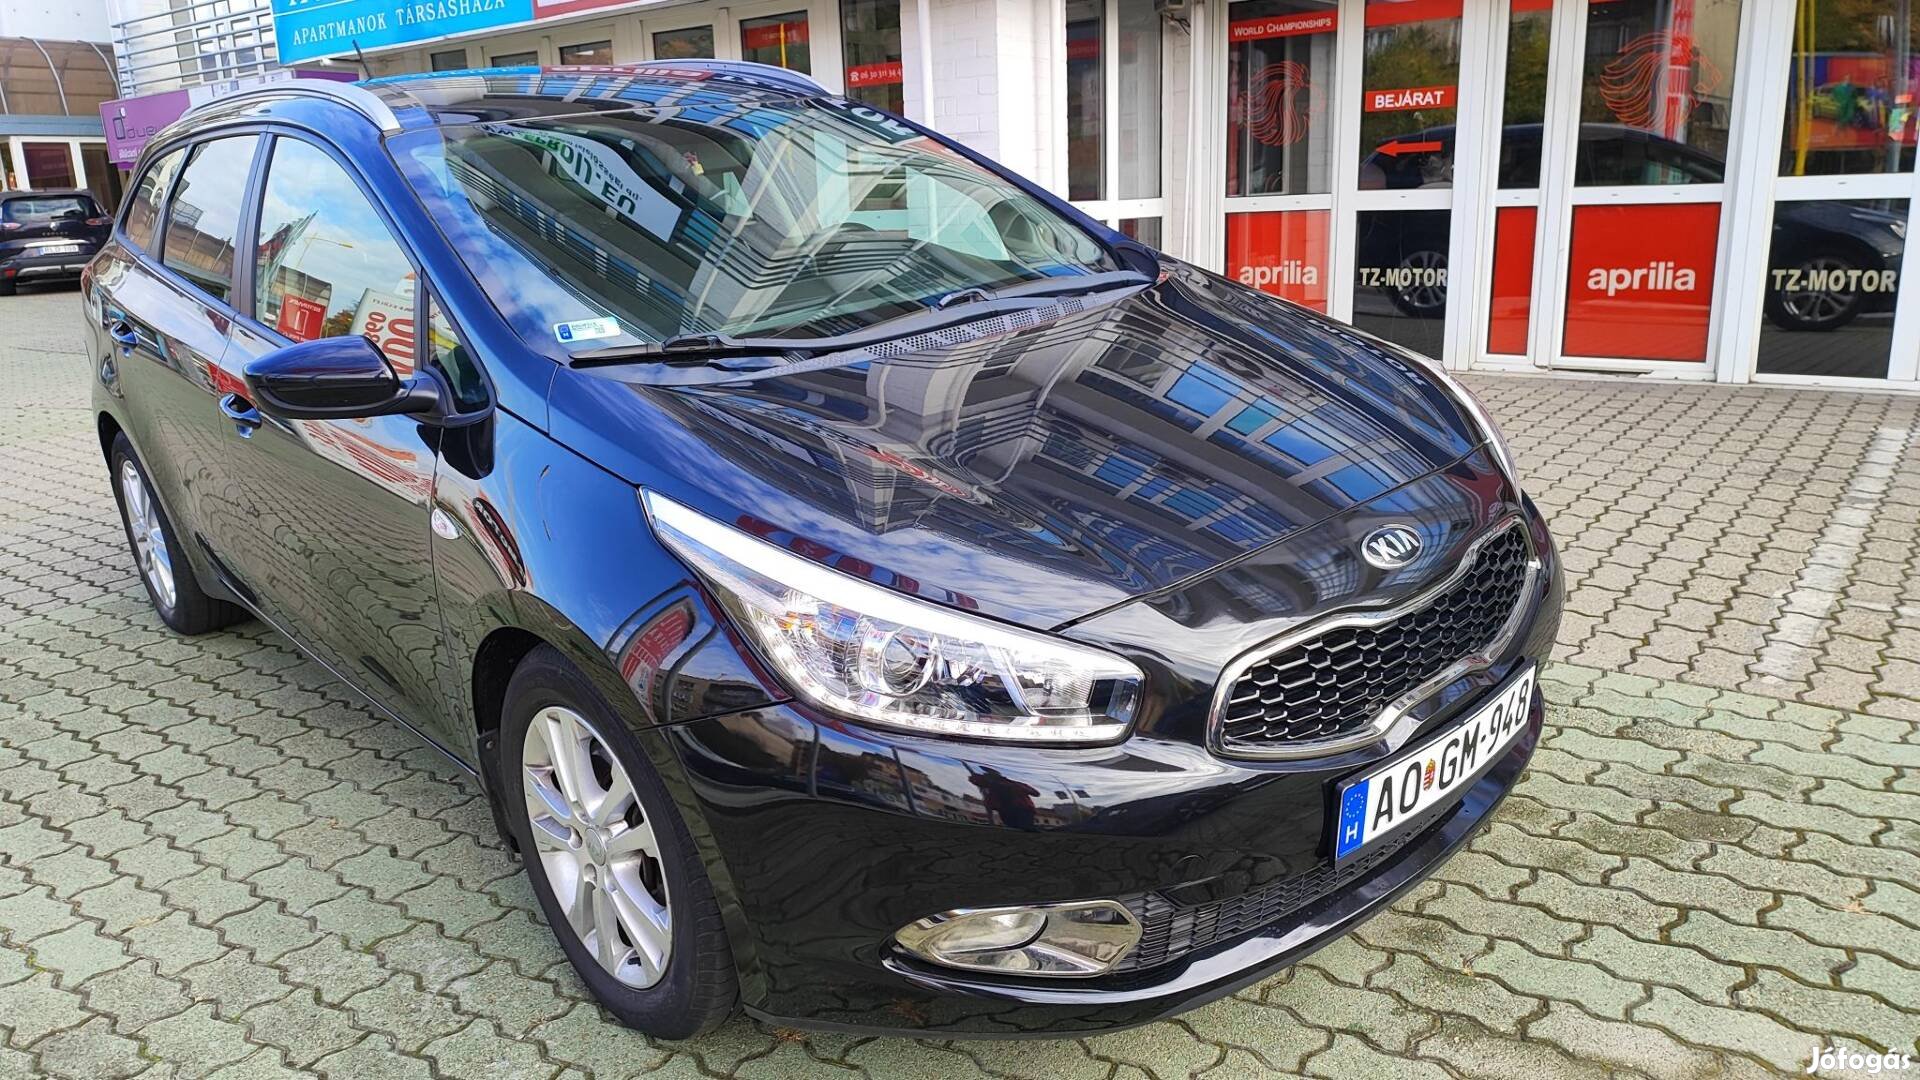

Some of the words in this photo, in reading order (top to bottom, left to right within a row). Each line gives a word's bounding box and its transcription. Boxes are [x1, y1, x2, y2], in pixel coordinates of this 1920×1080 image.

[293, 13, 387, 46] APARTMANOK
[1233, 25, 1265, 37] WORLD
[1266, 18, 1332, 33] CHAMPIONSHIPS
[1374, 89, 1445, 109] BEJÁRAT
[1239, 259, 1318, 289] aprilia
[1359, 267, 1448, 288] TZ-MOTOR
[1586, 261, 1696, 297] aprilia
[1771, 268, 1897, 293] TZ-MOTOR
[1369, 529, 1420, 562] KIA
[1372, 762, 1423, 832] AO
[1438, 677, 1531, 792] GM-948
[1345, 825, 1358, 845] H
